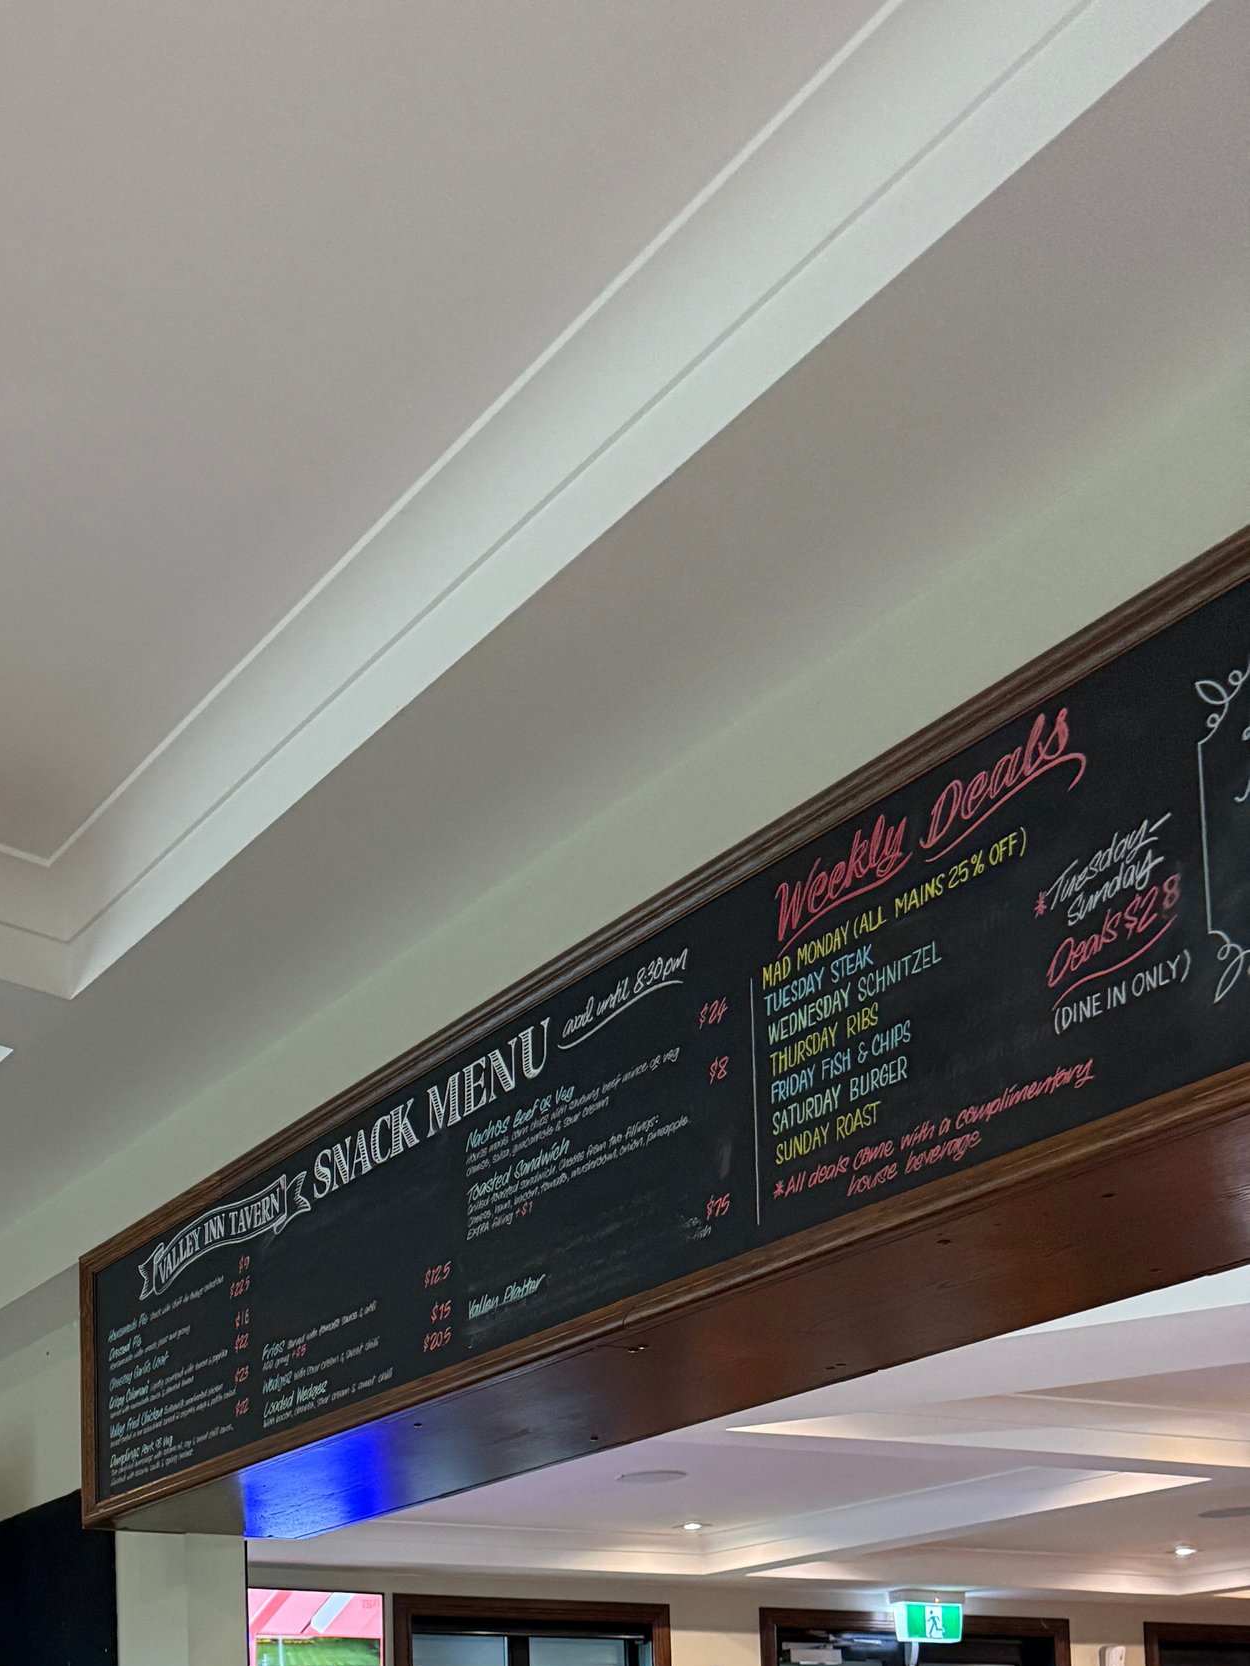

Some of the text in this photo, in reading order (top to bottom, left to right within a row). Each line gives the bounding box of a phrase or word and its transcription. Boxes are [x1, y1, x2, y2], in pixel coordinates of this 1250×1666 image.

[774, 707, 1069, 942] Weekly Deals
[762, 826, 1027, 991] MAD MONDAY (ALL MAINS 25% OFF)
[1067, 856, 1165, 926] Sunday
[1047, 873, 1182, 989] Deals $28
[596, 976, 630, 1015] until
[699, 997, 728, 1029] $24
[763, 943, 874, 1017] TUESDAY STEAK
[768, 941, 943, 1045] WEDNESDAY SCHNITZEL
[1053, 949, 1191, 1035] (DINE IN ONLY)
[709, 1055, 729, 1085] $8
[769, 1002, 880, 1077] THURSDAY RIBS
[770, 1020, 912, 1105] FRIDAY FISH & CHIPS
[312, 1016, 551, 1199] SNACK MENU
[602, 1073, 622, 1094] beef
[622, 1061, 649, 1083] mince
[772, 1055, 909, 1136] SATURDAY BURGER
[465, 1115, 510, 1153] Nachos
[513, 1098, 540, 1128] Beef
[555, 1085, 575, 1105] Veg
[775, 1100, 882, 1166] SUNDAY ROAST
[808, 1154, 851, 1184] deals
[852, 1139, 895, 1171] come
[900, 1120, 936, 1152] with
[938, 1117, 952, 1136] a
[955, 1058, 1096, 1130] complimentary
[467, 1137, 570, 1204] Toasted Sandwich
[491, 1182, 519, 1203] toasted
[586, 1141, 607, 1159] from
[608, 1131, 623, 1149] two
[846, 1130, 982, 1197] house beverage
[156, 1188, 283, 1285] VALLEY INN TAVERN
[466, 1220, 490, 1241] EXTRA
[238, 1255, 250, 1274] $9
[424, 1261, 452, 1289] $12.5
[502, 1273, 546, 1305] Platter
[423, 1327, 452, 1353] $20.5
[431, 1300, 452, 1324] $15
[262, 1340, 286, 1361] Fries
[262, 1370, 293, 1394] Wedges
[263, 1389, 295, 1419] Loaded
[296, 1379, 328, 1403] Wedges
